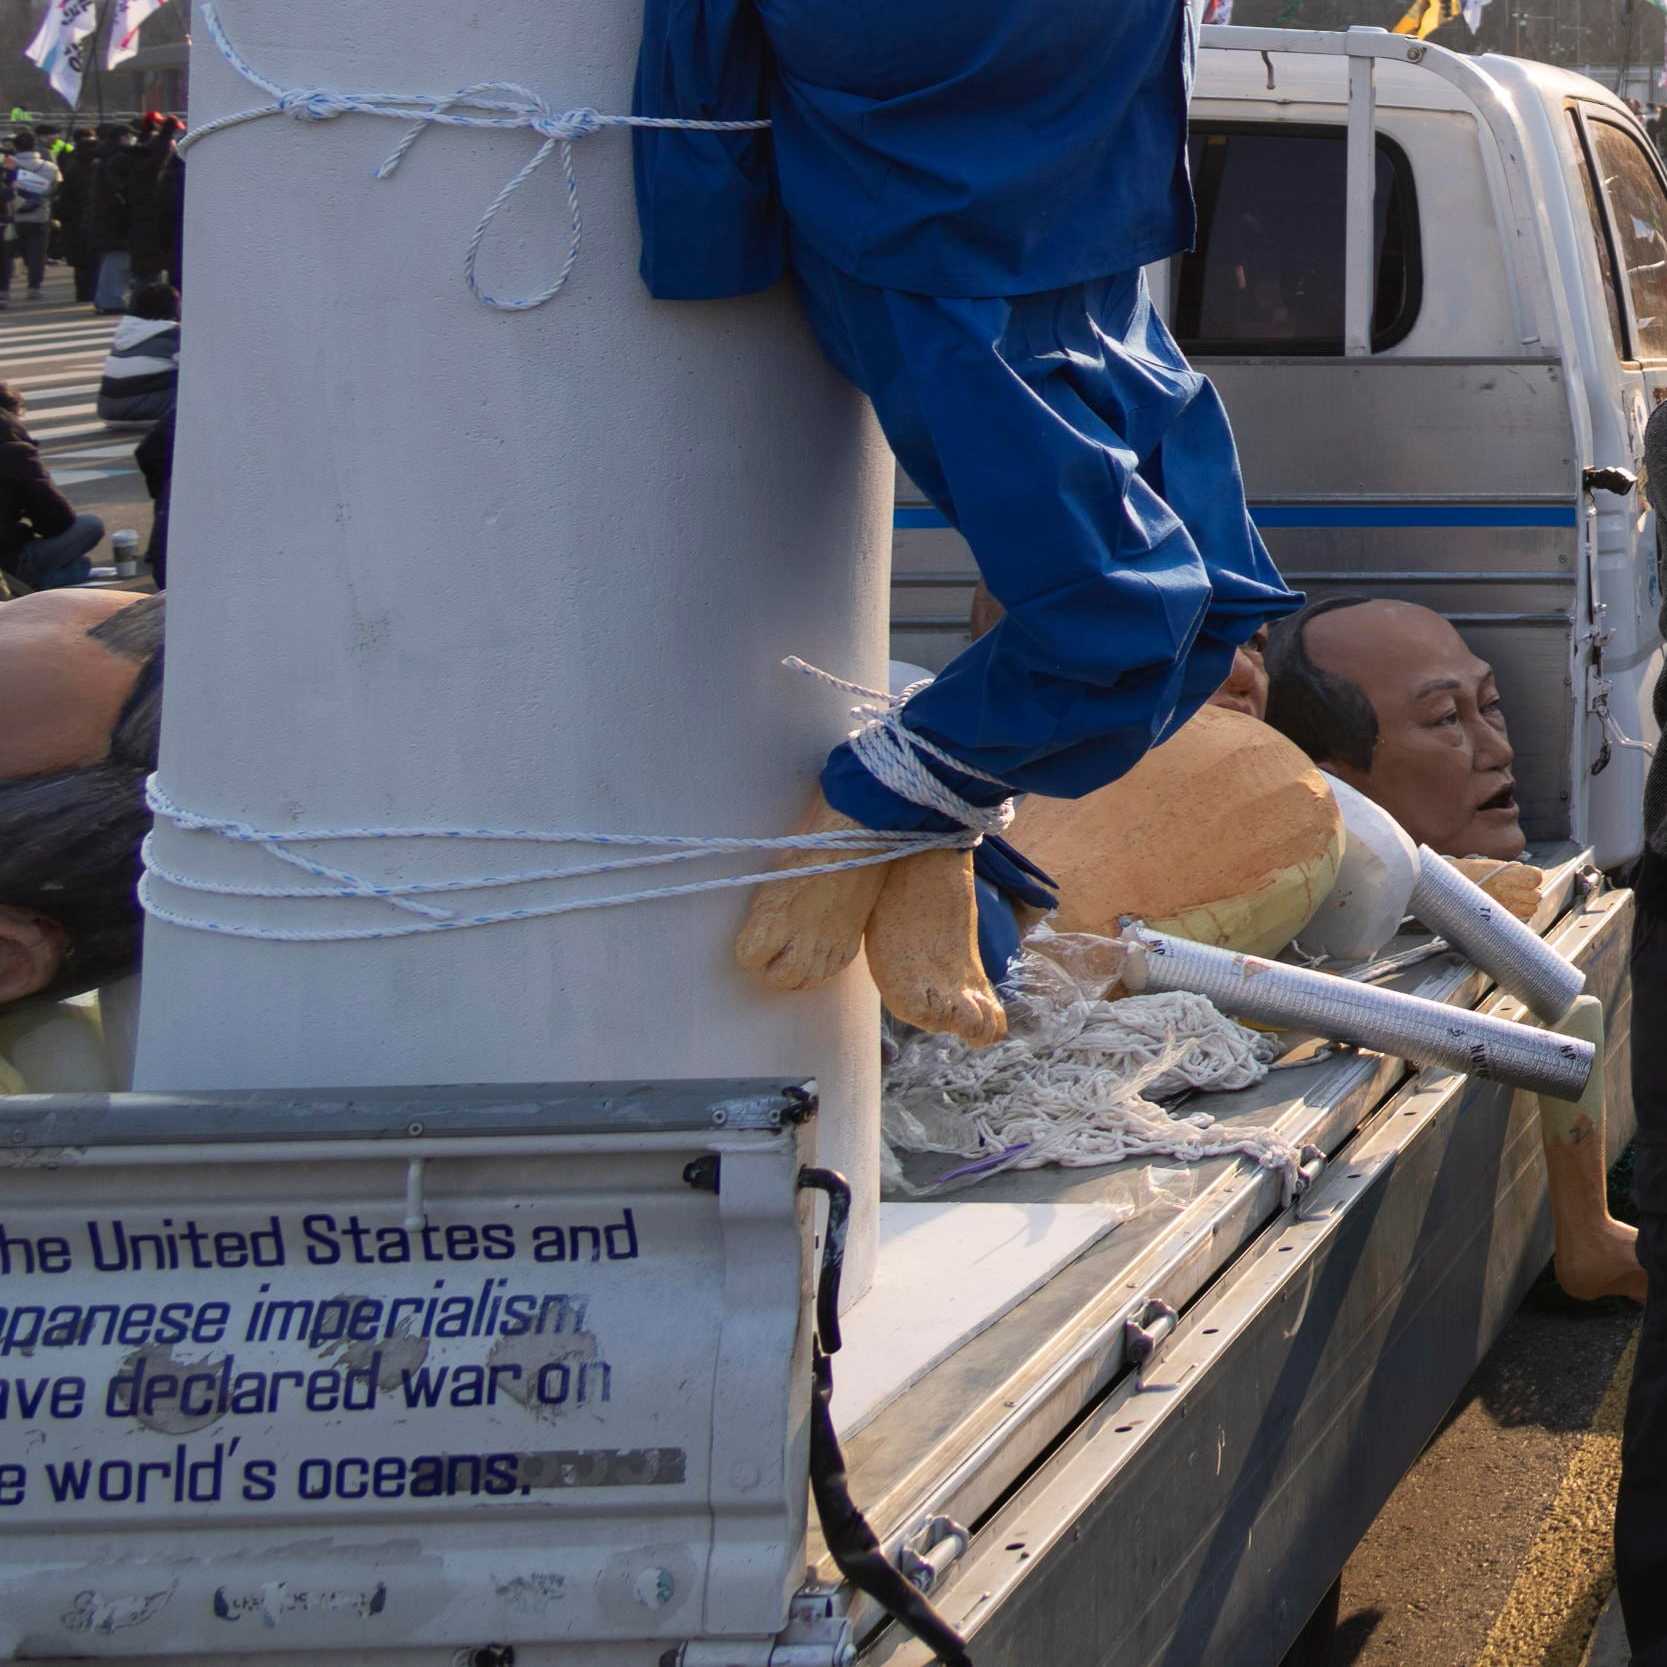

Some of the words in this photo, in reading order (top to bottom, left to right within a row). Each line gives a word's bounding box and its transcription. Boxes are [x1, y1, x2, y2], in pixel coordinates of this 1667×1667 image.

[0, 1221, 73, 1275] he
[87, 1215, 286, 1273] United
[302, 1212, 517, 1267] States
[532, 1208, 640, 1264] and
[245, 1276, 589, 1347] imperialism
[106, 1351, 382, 1419] declared
[399, 1360, 523, 1411] war
[537, 1357, 612, 1406] on
[43, 1436, 277, 1503] world's
[298, 1448, 534, 1501] oceans.
